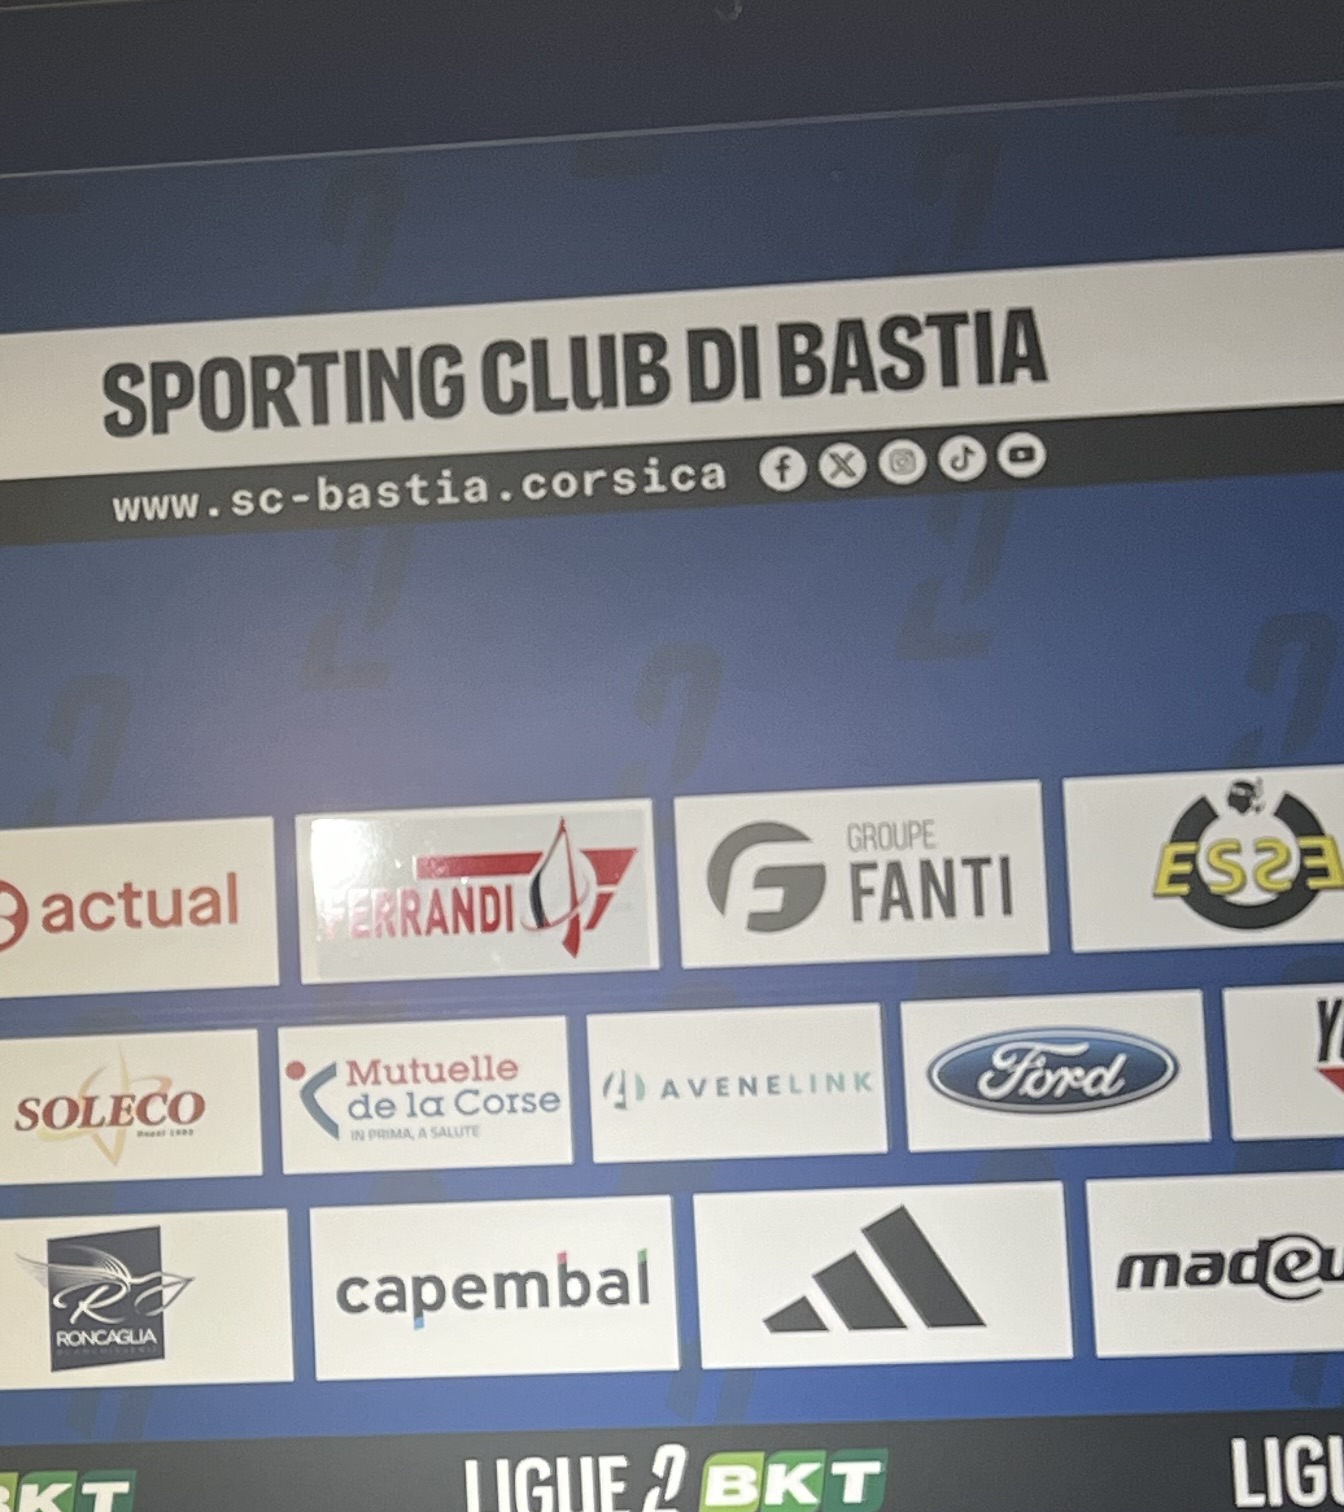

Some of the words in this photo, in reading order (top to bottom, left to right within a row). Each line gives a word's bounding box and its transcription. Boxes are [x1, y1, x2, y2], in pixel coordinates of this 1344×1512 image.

[103, 344, 464, 437] SPORTING
[482, 332, 670, 415] CLUB
[687, 325, 760, 403] DI
[778, 307, 1048, 397] BASTIA
[113, 458, 725, 521] www.sc-bastia.corsica
[848, 819, 936, 852] GROUPE
[42, 872, 237, 933] actual
[851, 856, 1012, 922] FANTI
[346, 1055, 518, 1086] Mutuelle
[661, 1072, 871, 1099] AVENELINK
[977, 1041, 1127, 1101] Ford
[15, 1092, 205, 1134] SOLECO
[348, 1094, 396, 1120] de
[406, 1092, 444, 1117] la
[454, 1089, 560, 1115] Corse
[337, 1250, 649, 1328] capembal
[57, 1329, 157, 1346] RONCAGLIA
[704, 1461, 883, 1507] BKT
